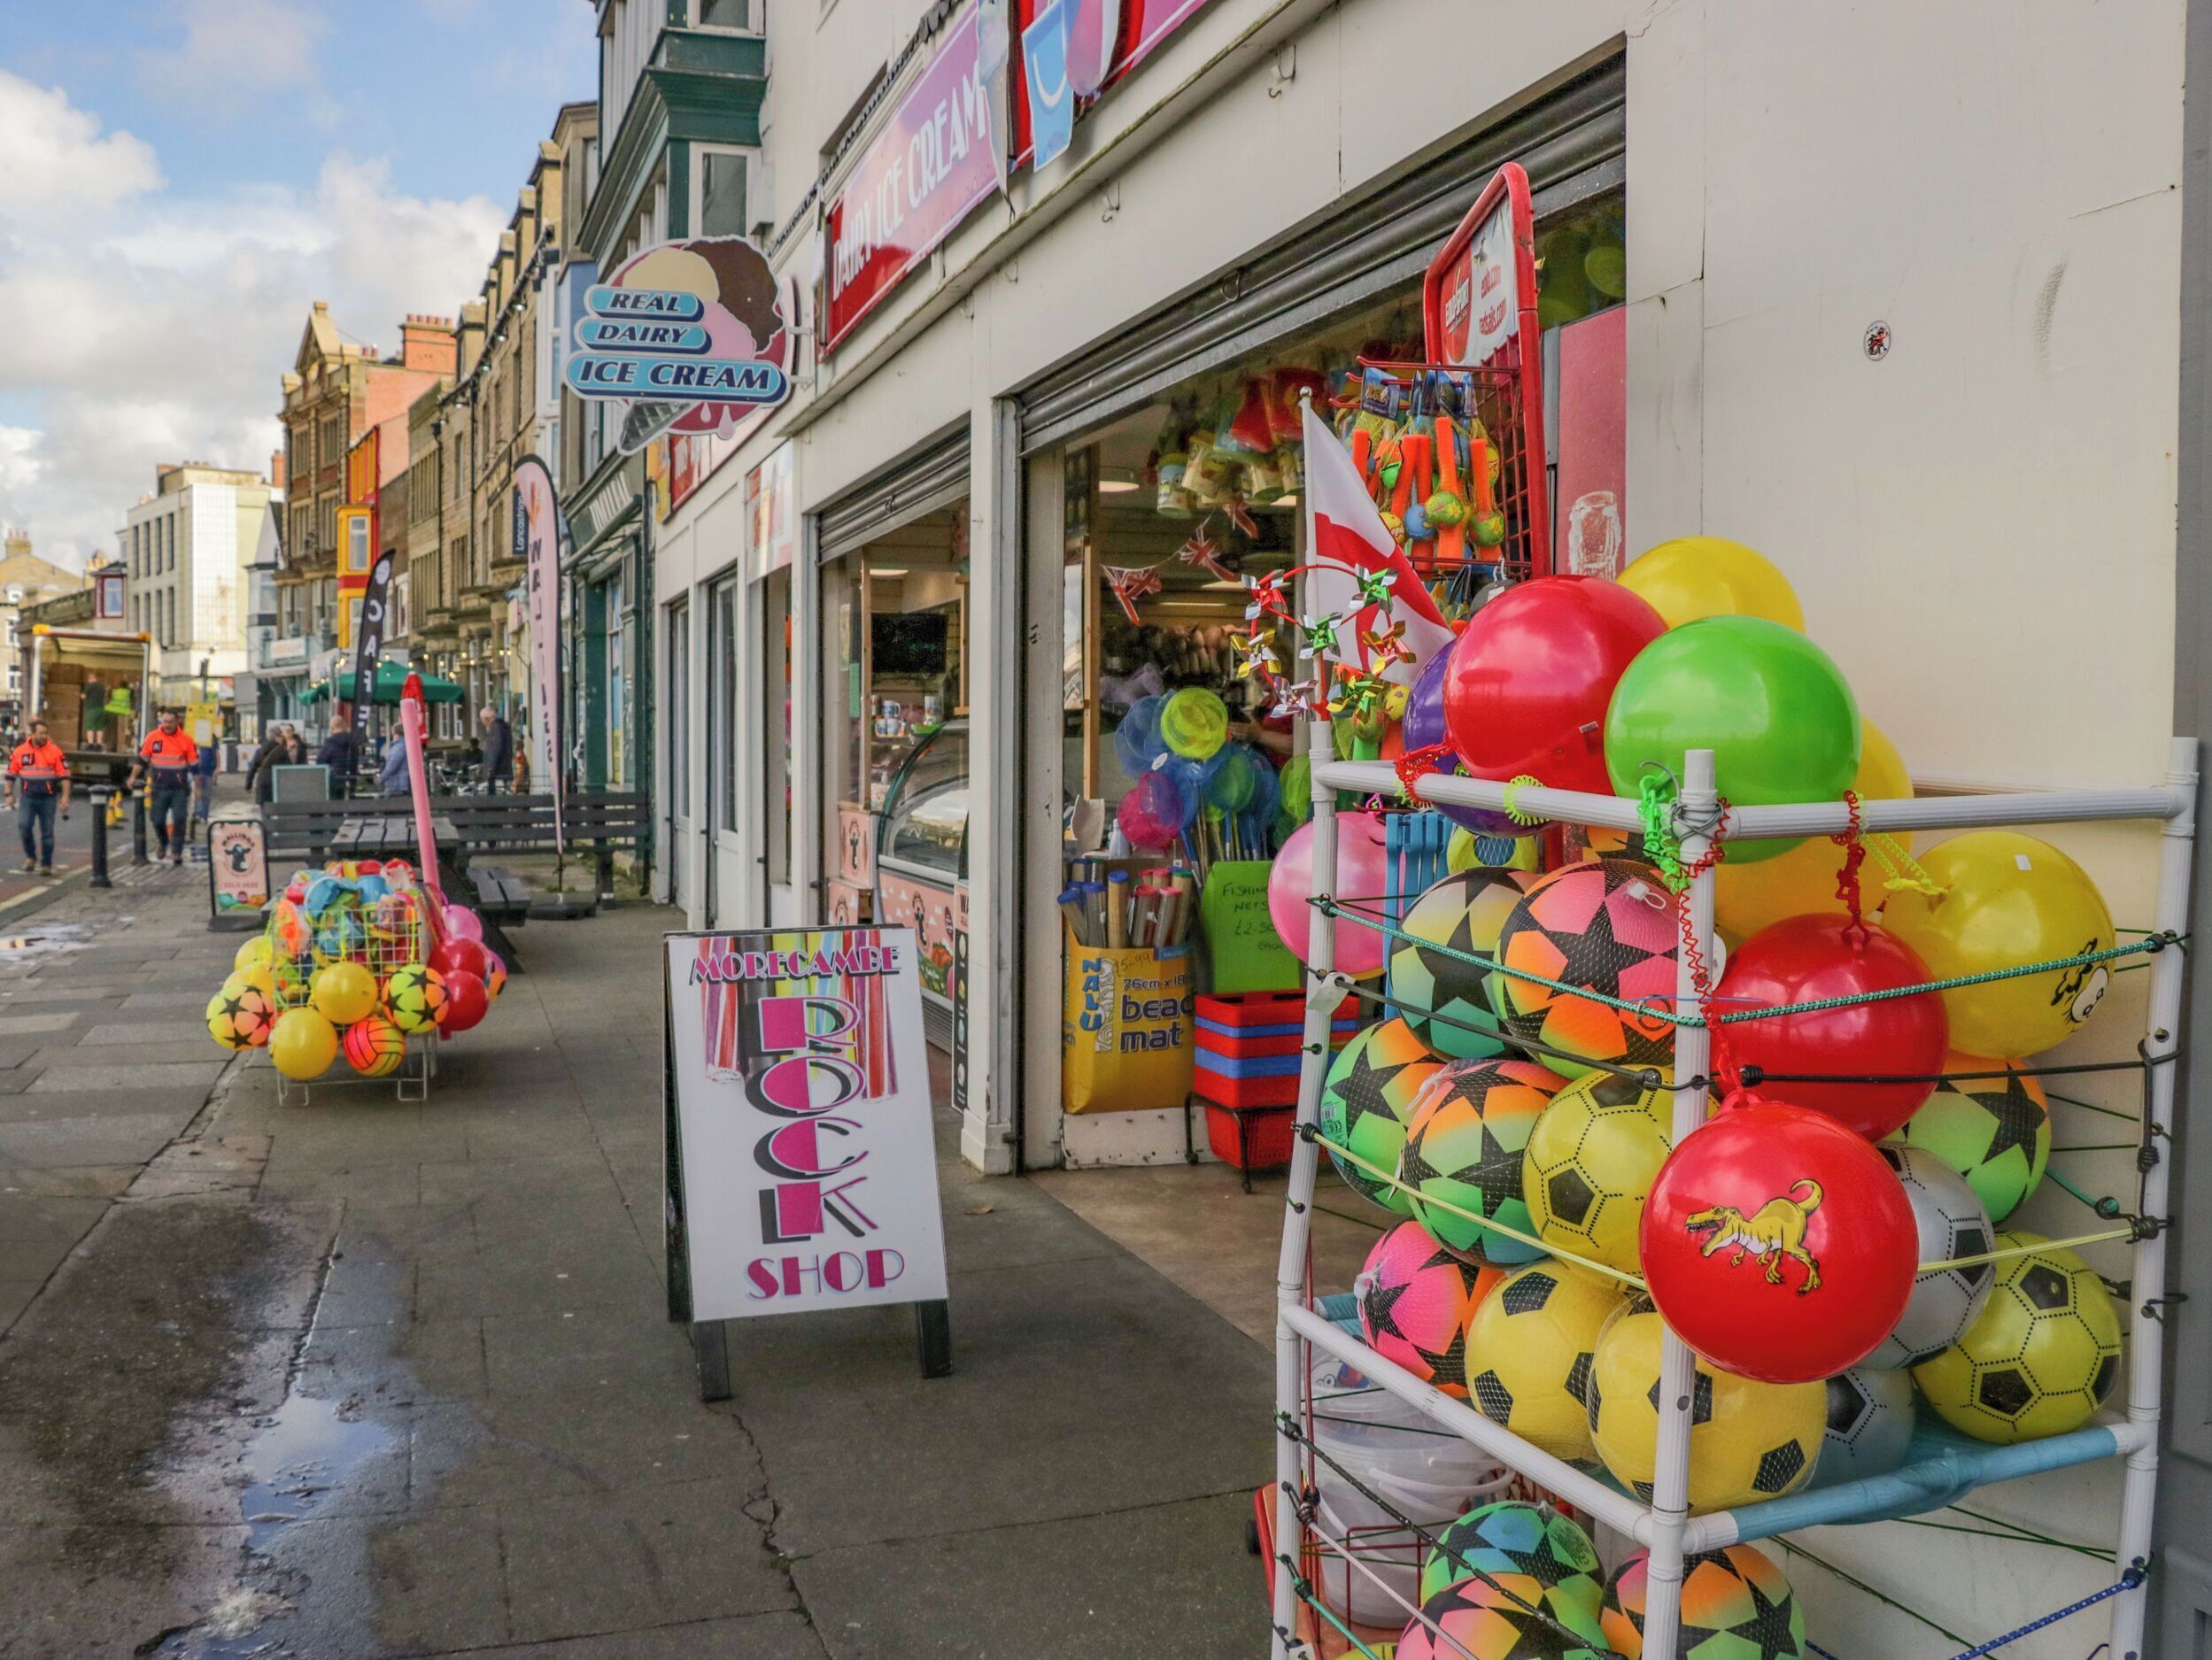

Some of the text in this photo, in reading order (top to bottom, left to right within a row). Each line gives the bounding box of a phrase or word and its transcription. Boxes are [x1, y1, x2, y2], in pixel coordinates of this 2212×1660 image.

[832, 58, 986, 301] DAIRY ICE CREAM
[610, 293, 681, 313] REAL
[597, 323, 689, 344] DAIRY
[580, 359, 770, 390] ICE CREAM
[691, 946, 901, 984] MORECAMBE
[1124, 978, 1160, 990] 76cm
[1122, 994, 1194, 1022] beac
[1119, 1022, 1182, 1052] mat
[751, 996, 878, 1242] ROCK
[746, 1248, 905, 1299] SHOP
